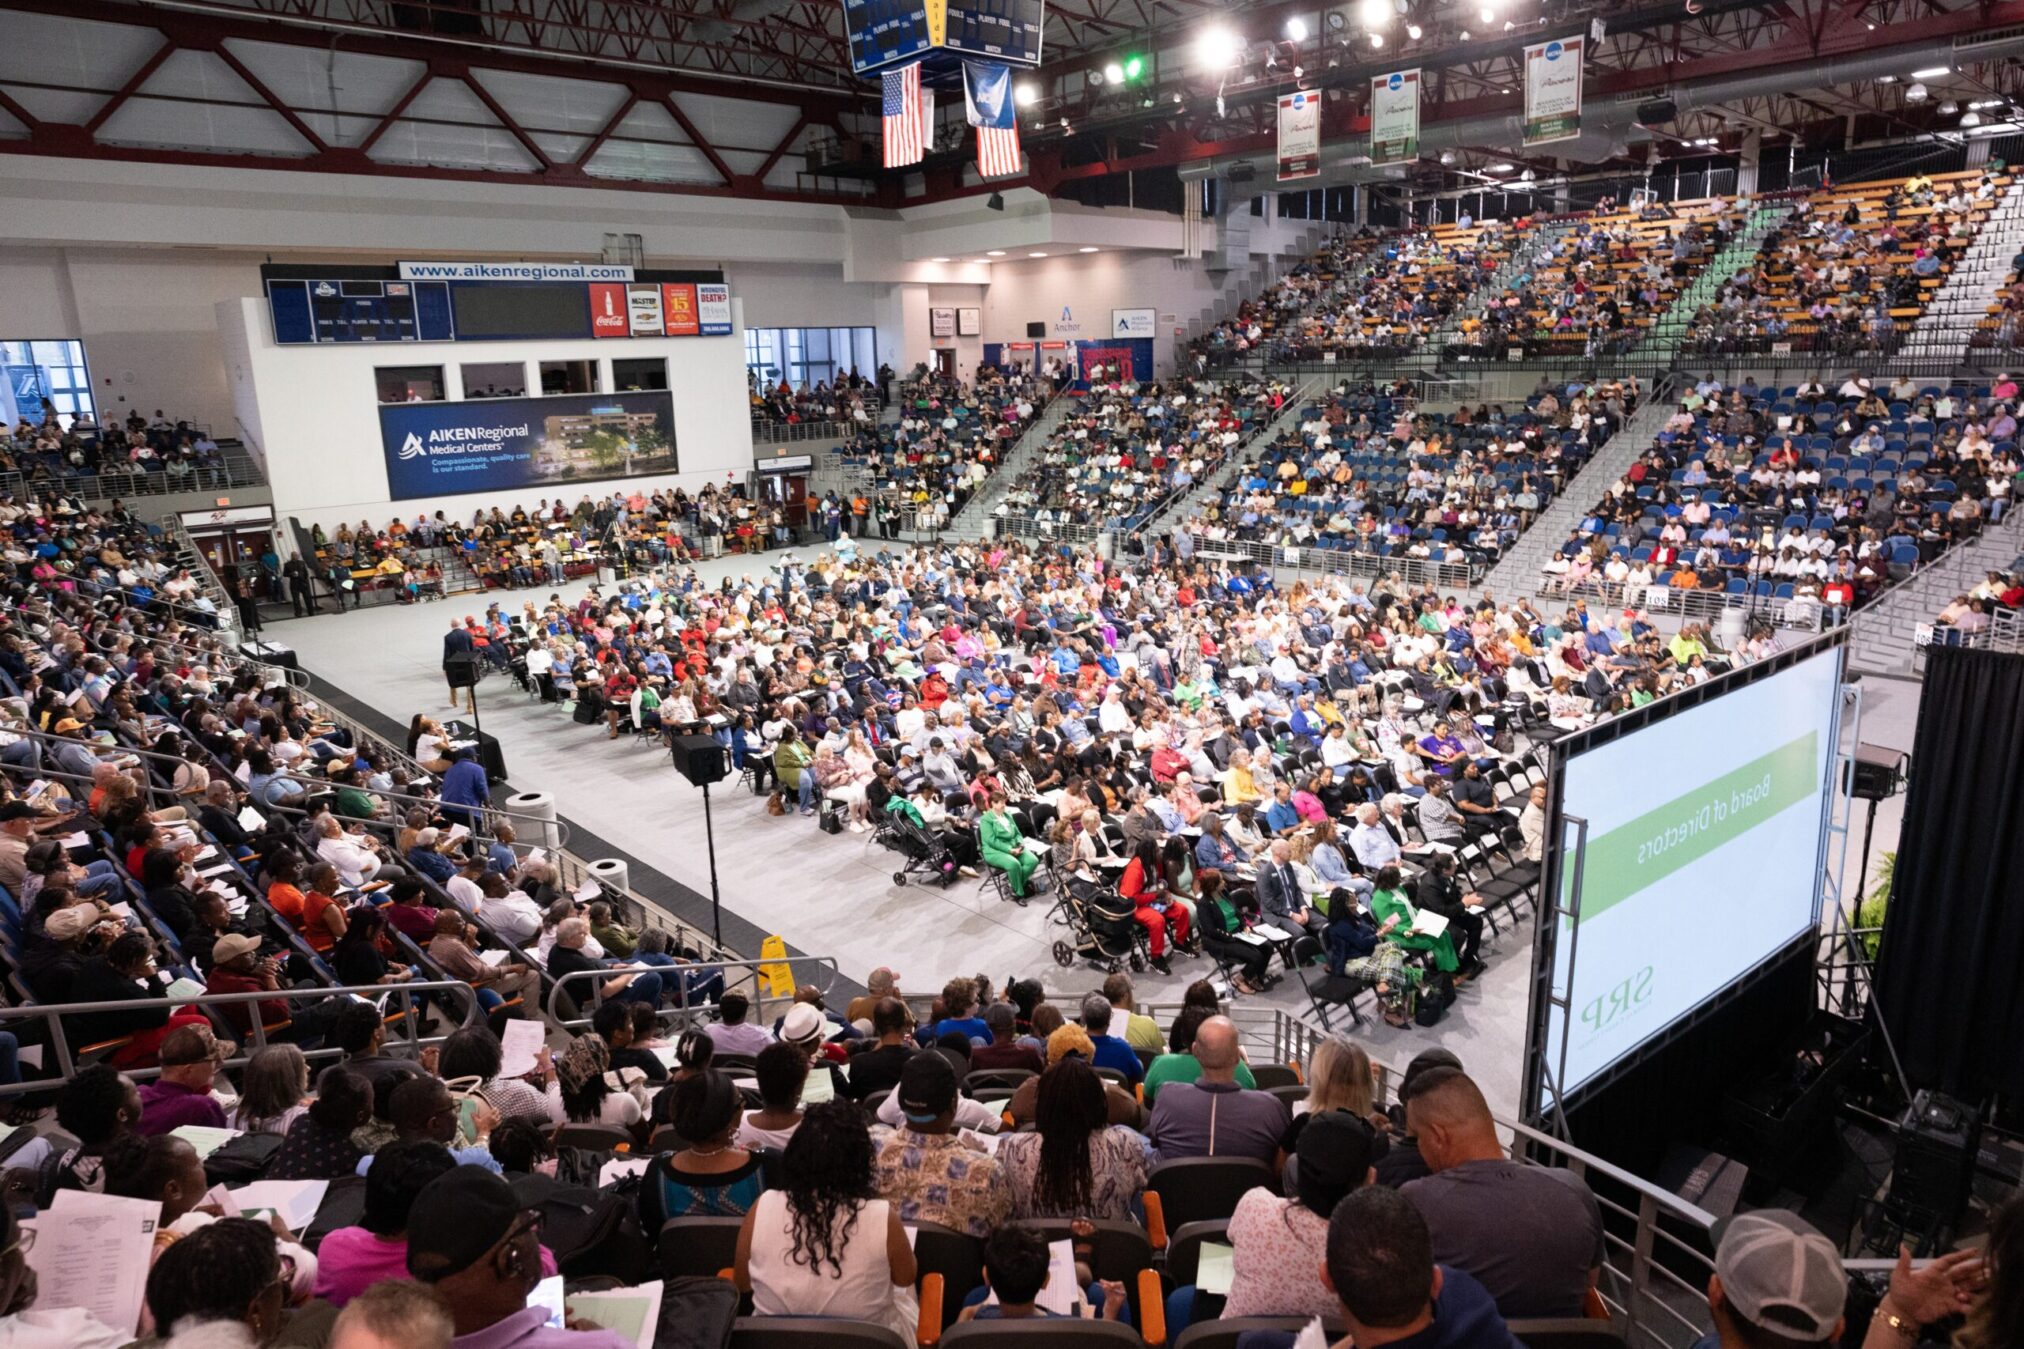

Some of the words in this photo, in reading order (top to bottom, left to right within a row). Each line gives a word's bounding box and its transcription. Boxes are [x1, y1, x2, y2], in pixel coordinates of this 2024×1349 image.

[409, 264, 626, 280] www.aikenregional.com
[672, 297, 689, 311] 15
[701, 294, 727, 303] DEATH?
[1054, 322, 1081, 332] Anchor
[430, 443, 465, 455] Medical
[432, 456, 490, 466] Compassionate,
[490, 453, 514, 462] quality
[516, 452, 530, 460] care
[454, 463, 488, 471] standard.
[1648, 596, 1666, 606] 105
